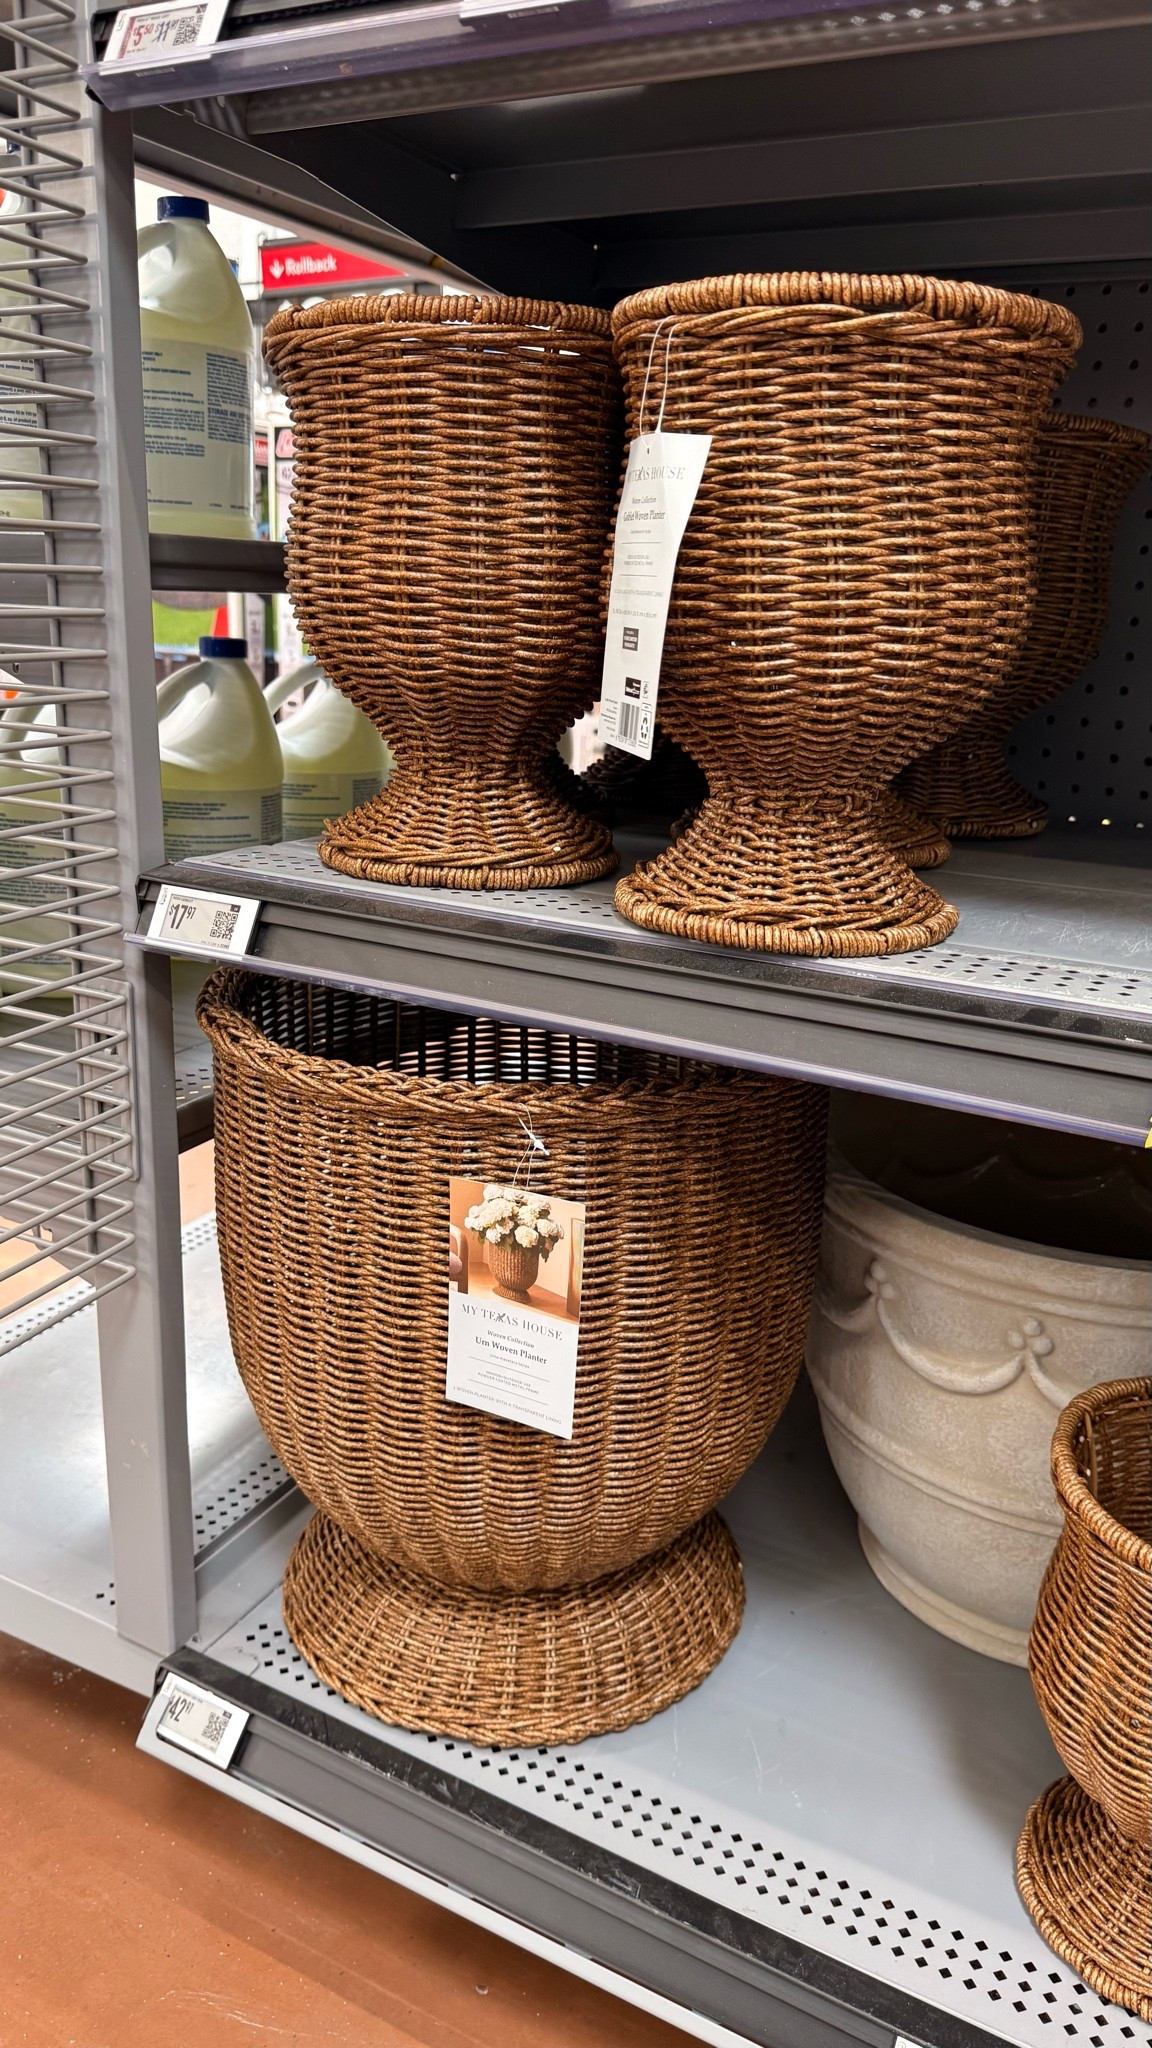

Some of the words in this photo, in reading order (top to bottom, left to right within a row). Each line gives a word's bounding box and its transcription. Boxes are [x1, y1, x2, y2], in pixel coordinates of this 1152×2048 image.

[285, 253, 337, 276] Rollback
[651, 466, 686, 480] HOUSE
[462, 1303, 478, 1315] MY
[480, 1308, 519, 1326] TEXAS
[522, 1320, 563, 1340] HOUSE
[475, 1336, 490, 1347] Urn
[492, 1341, 518, 1355] Woven
[520, 1349, 548, 1364] Planter
[487, 1330, 506, 1340] Woven
[507, 1336, 534, 1348] Collection
[474, 1392, 494, 1402] PLANTER
[513, 1404, 545, 1418] TRANSPARENT
